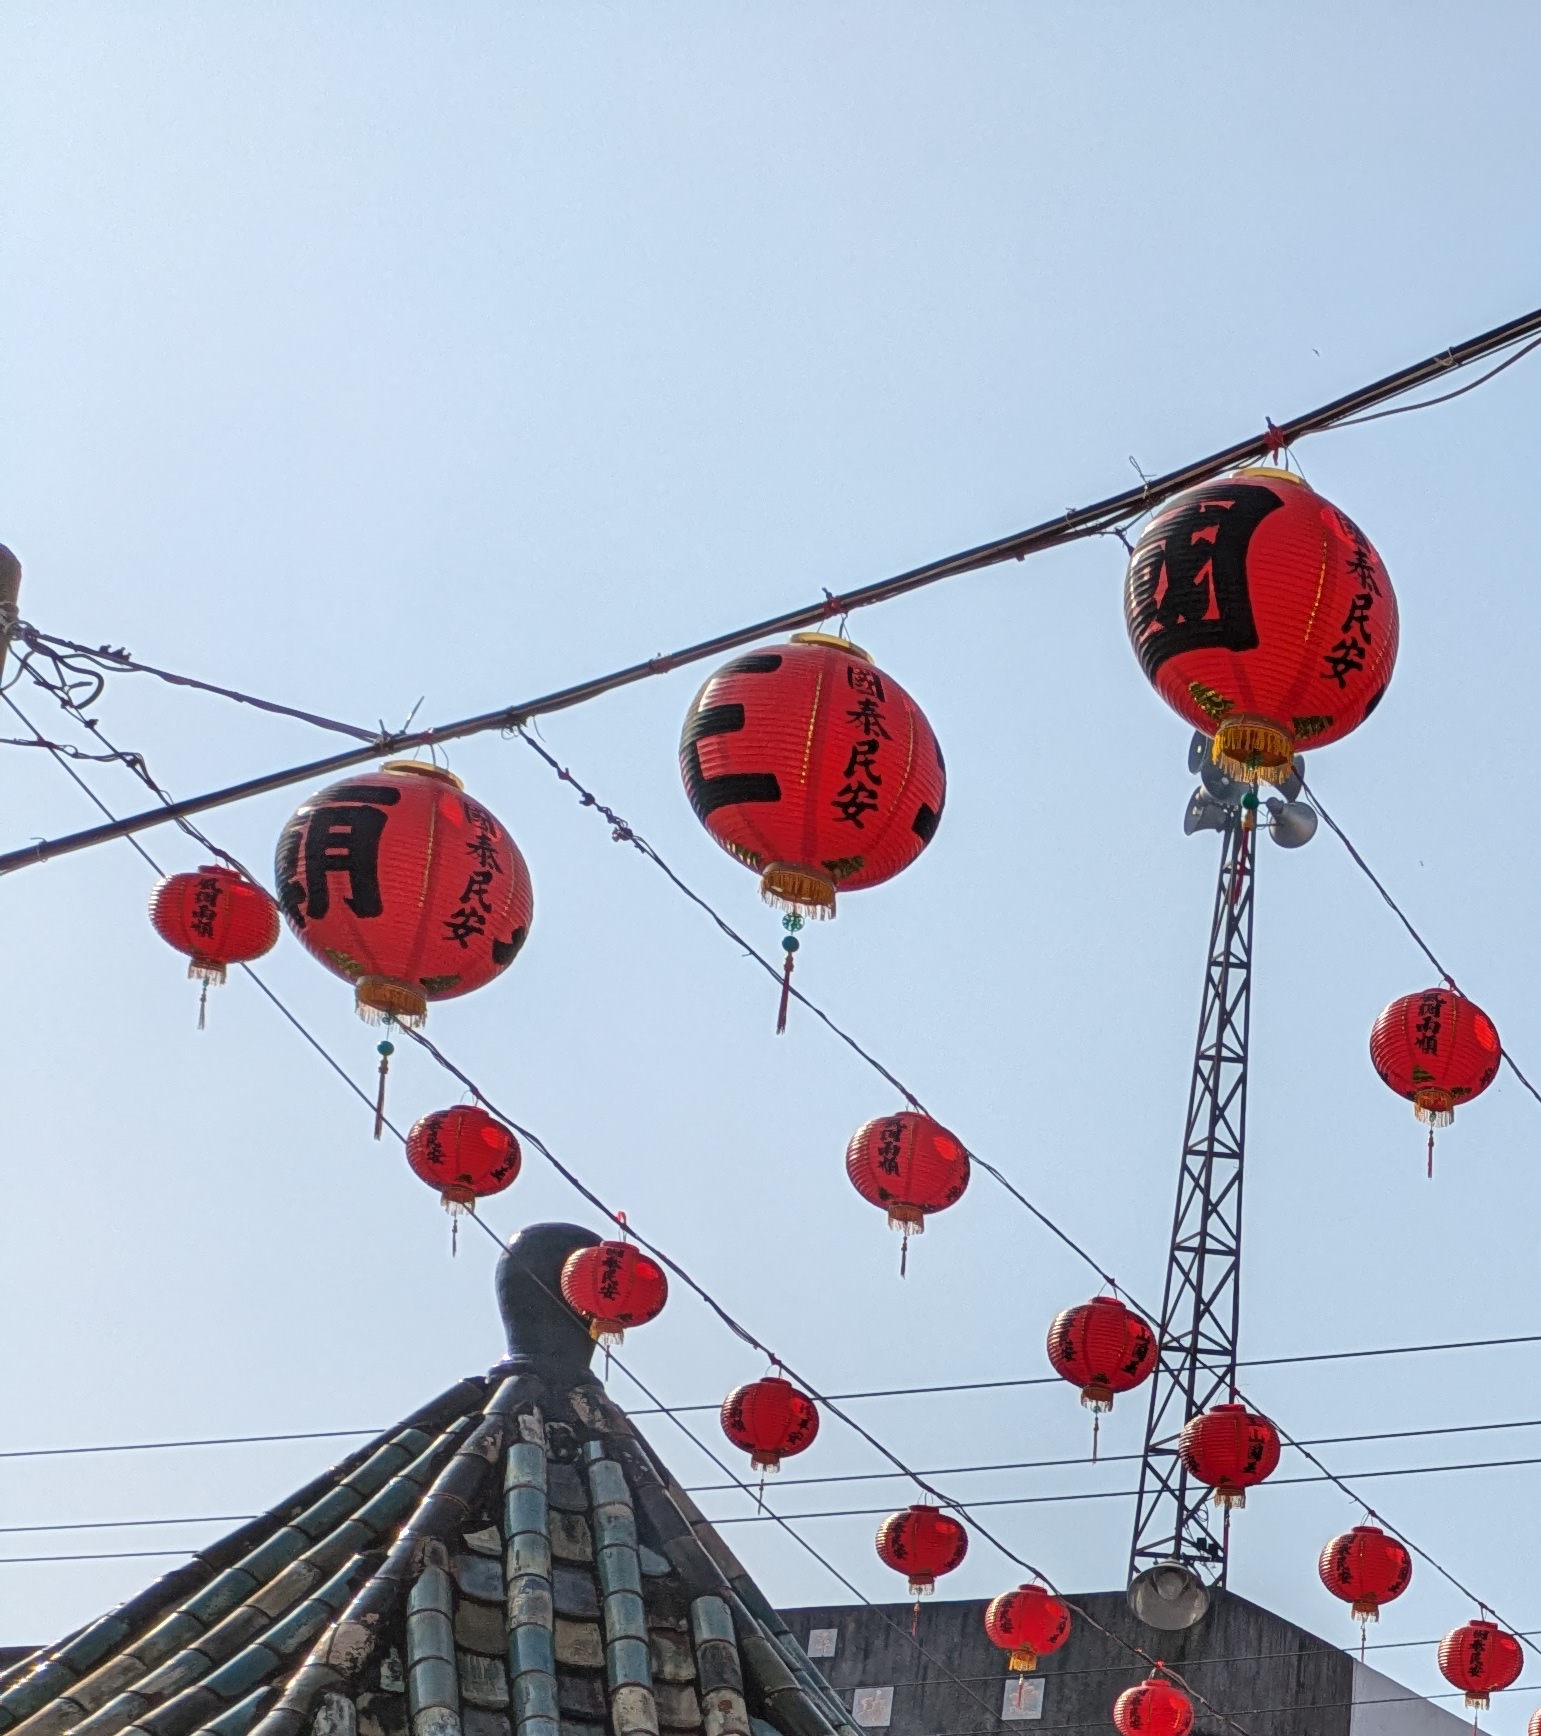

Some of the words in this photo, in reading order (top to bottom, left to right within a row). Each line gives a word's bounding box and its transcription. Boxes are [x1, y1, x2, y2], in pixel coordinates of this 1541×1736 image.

[832, 665, 893, 829] 國泰民安
[443, 801, 501, 949] 國泰民安
